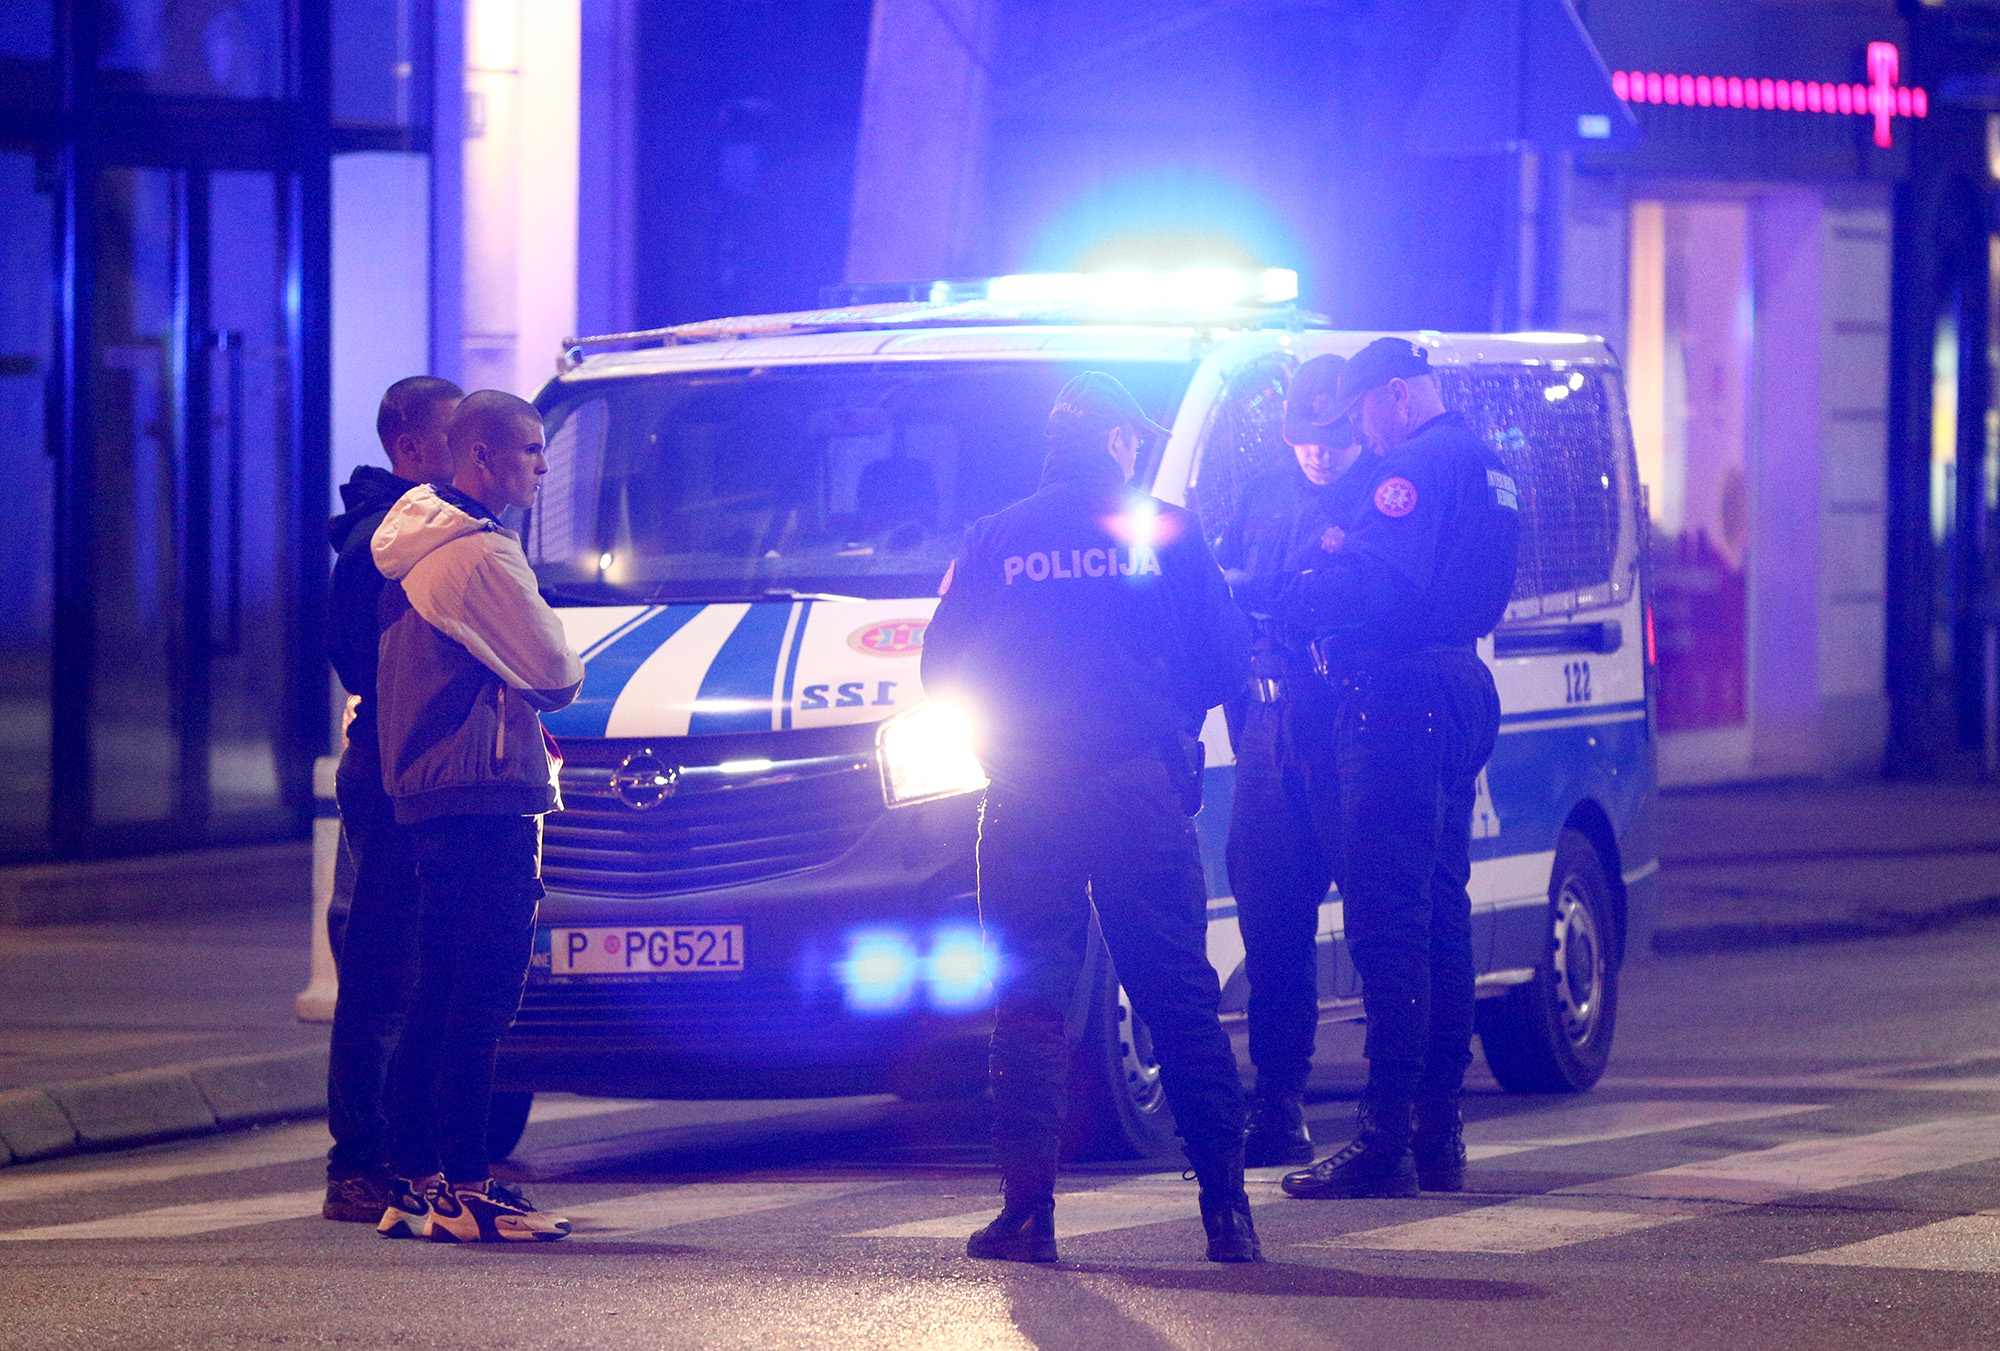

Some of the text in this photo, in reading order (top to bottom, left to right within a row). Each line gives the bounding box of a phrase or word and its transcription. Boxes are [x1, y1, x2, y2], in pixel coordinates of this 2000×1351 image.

[1003, 547, 1163, 585] POLICIJA
[1563, 661, 1593, 704] 122
[567, 930, 740, 969] P PG521
